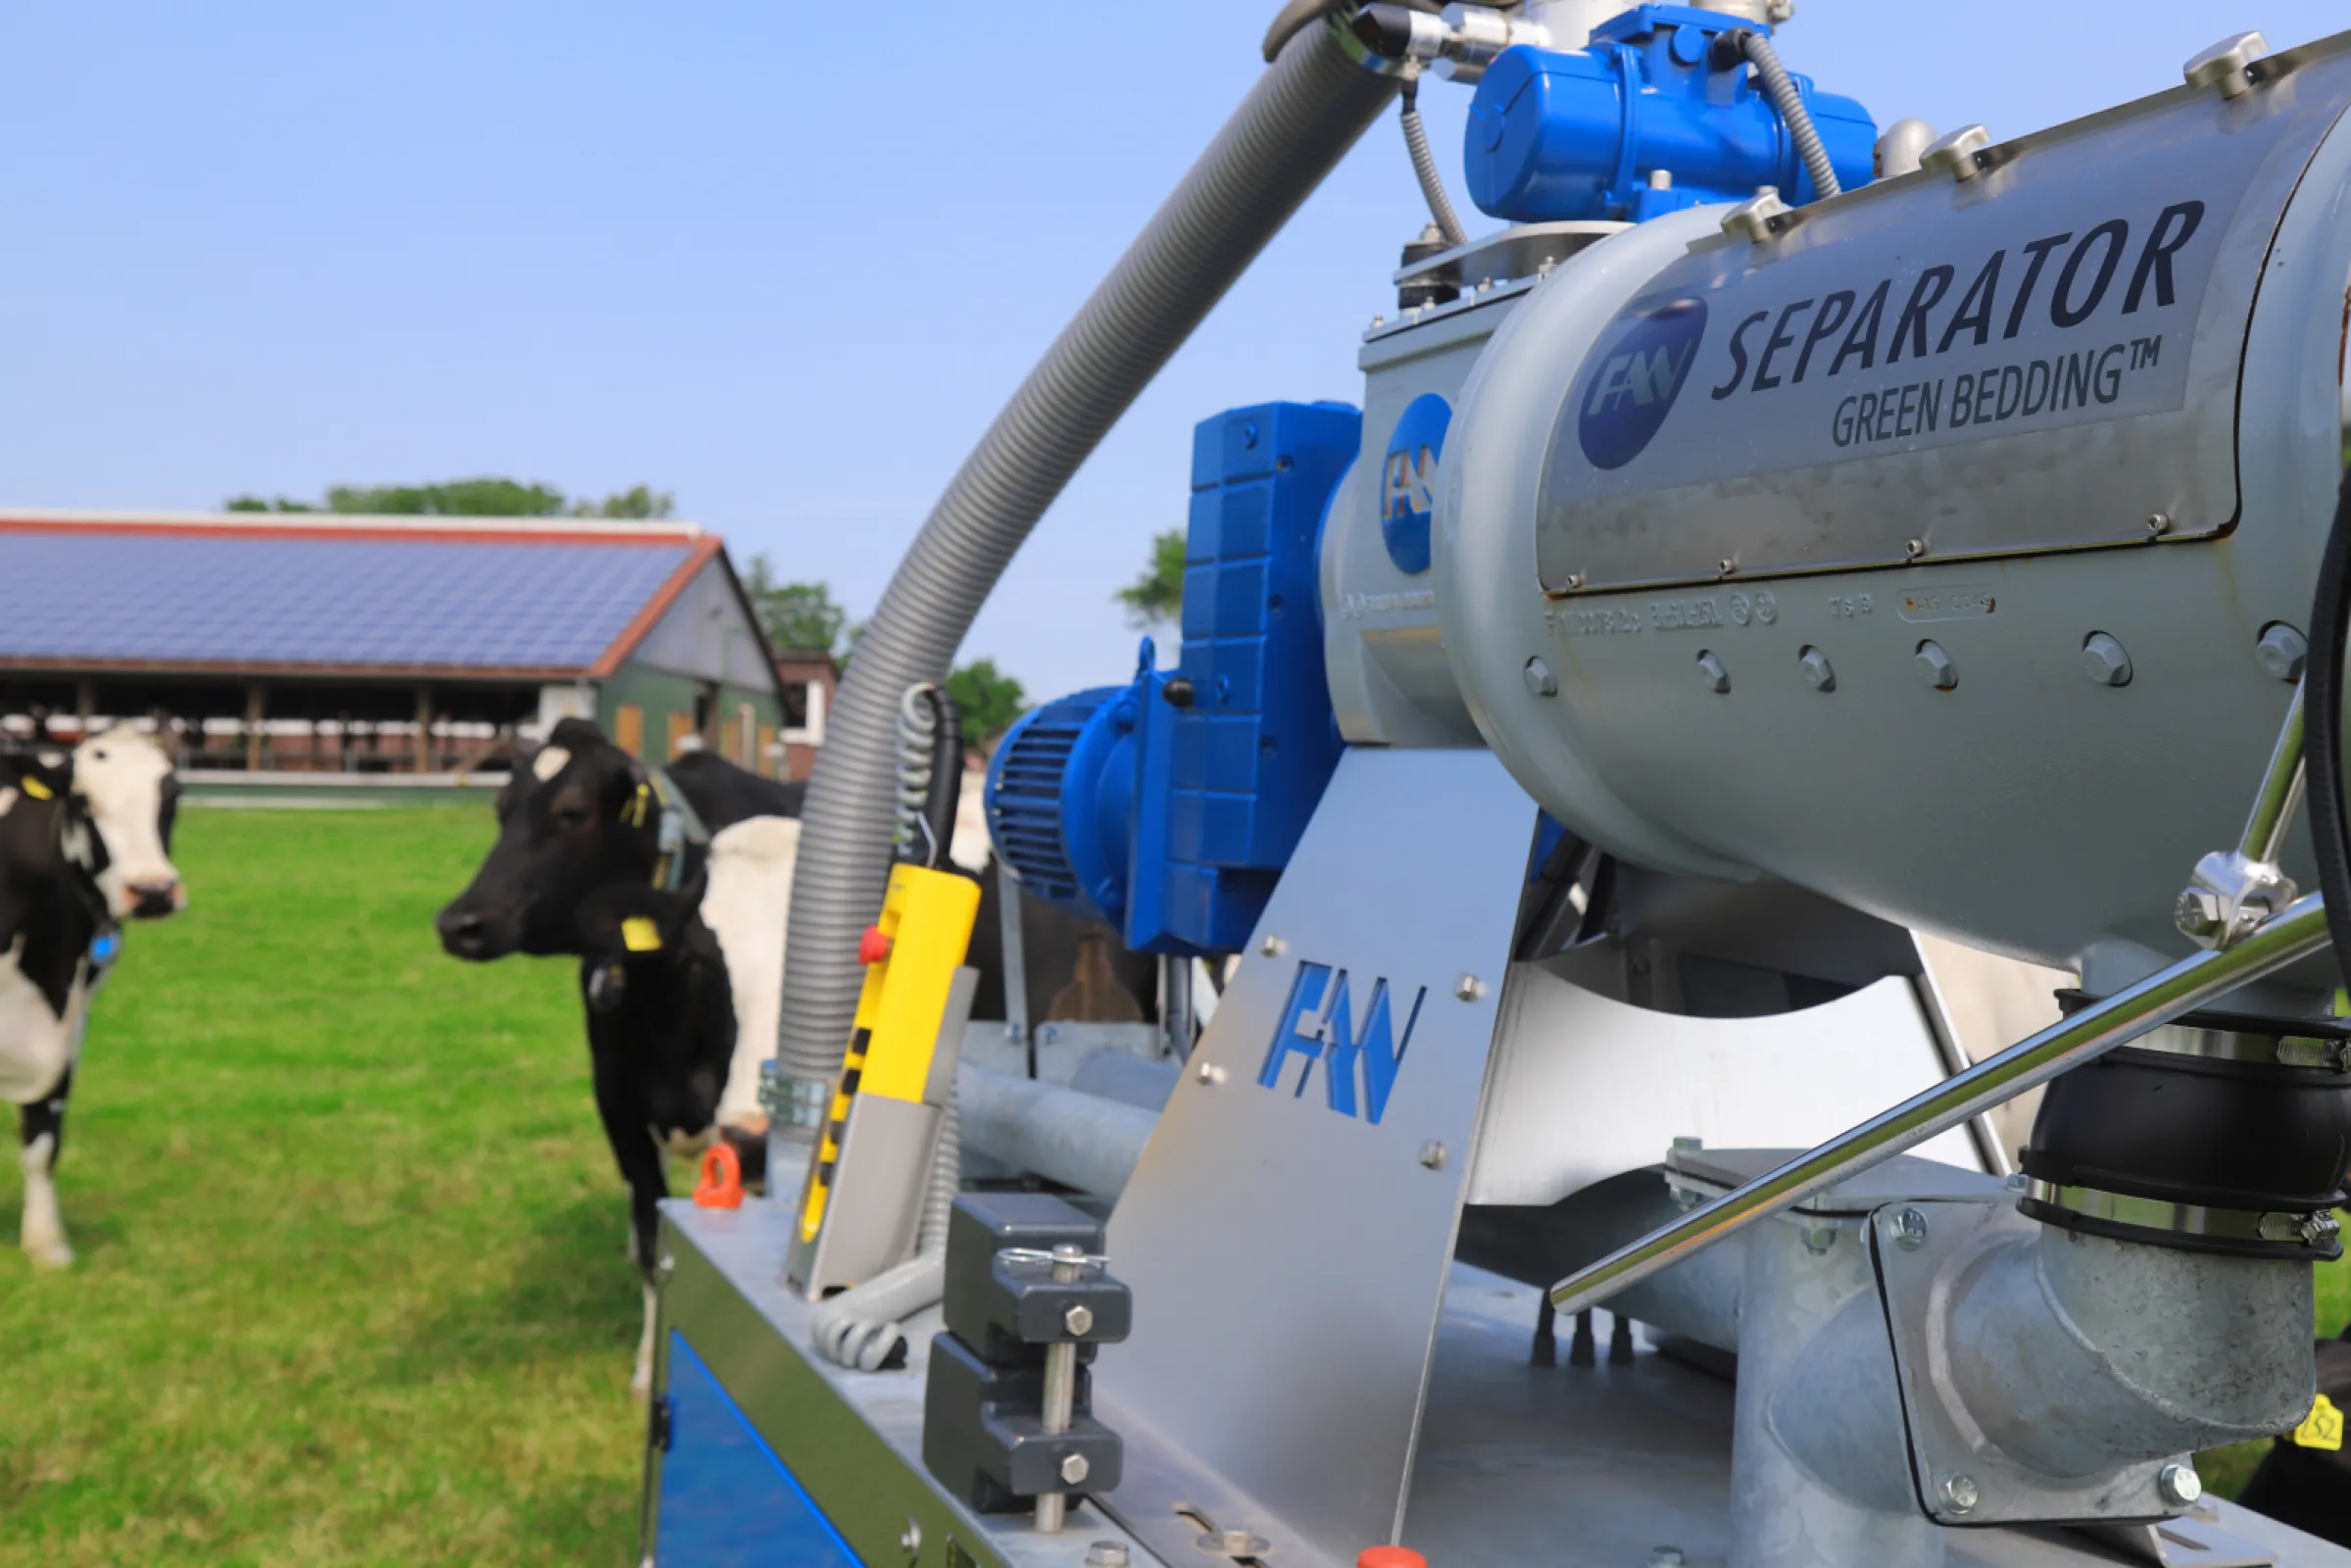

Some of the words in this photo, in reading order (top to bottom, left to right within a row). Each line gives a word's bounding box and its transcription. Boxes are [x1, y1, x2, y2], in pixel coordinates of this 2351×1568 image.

[1711, 200, 2205, 401] SEPARATOR
[1832, 378, 1944, 447] GREEN
[1256, 958, 1428, 1126] FAN
